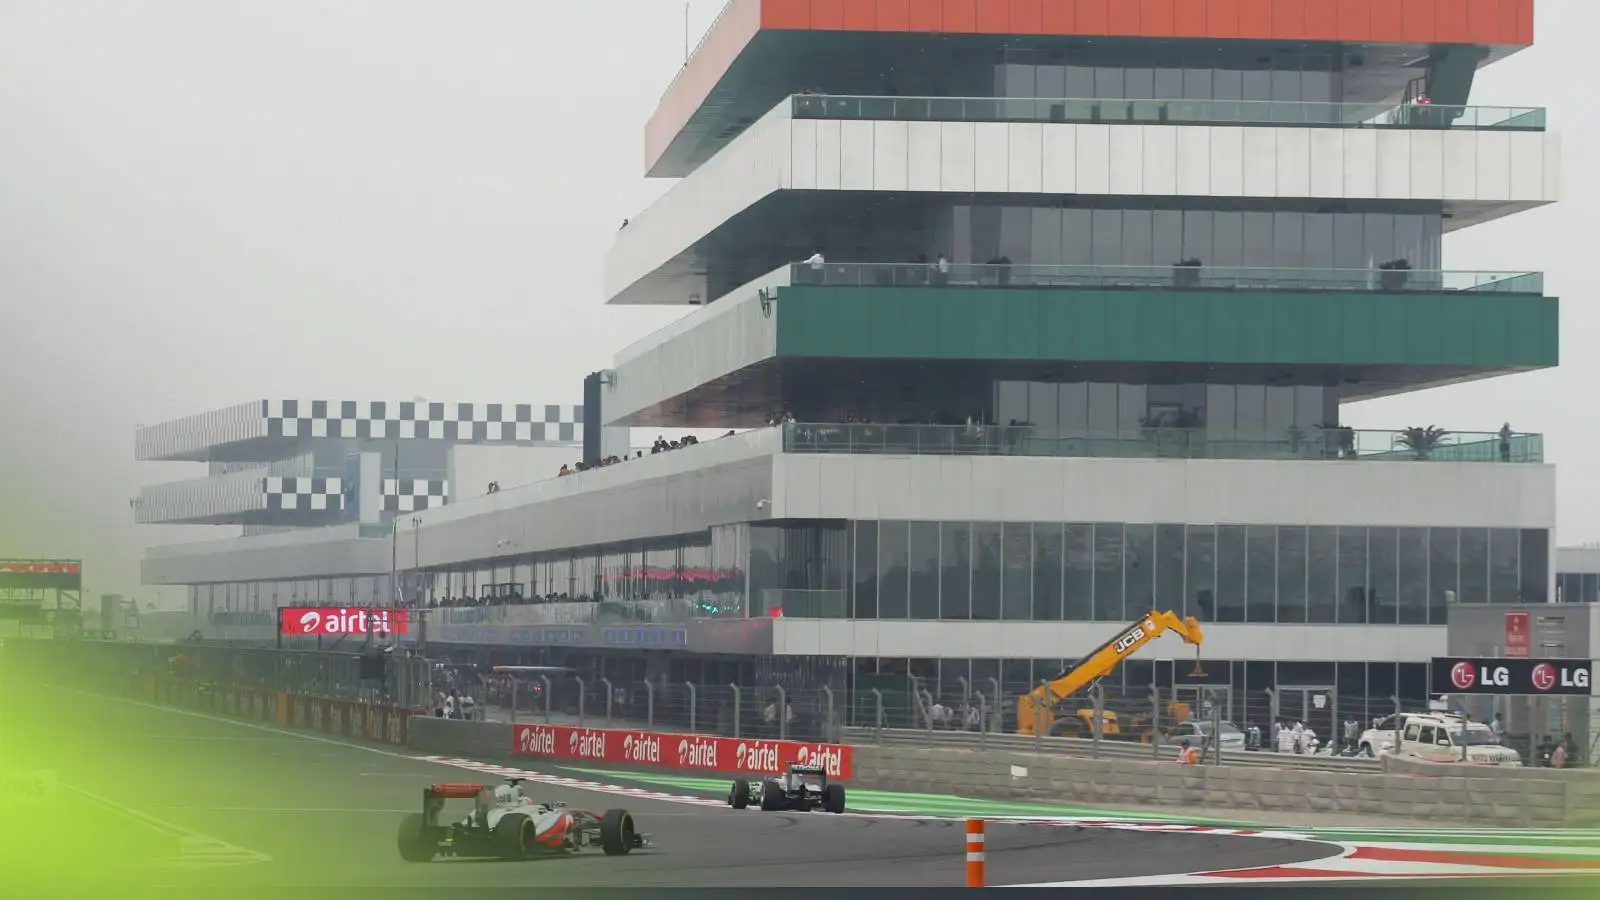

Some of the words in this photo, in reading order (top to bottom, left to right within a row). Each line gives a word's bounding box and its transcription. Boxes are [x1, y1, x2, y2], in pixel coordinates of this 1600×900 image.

[325, 609, 391, 633] airtel
[1116, 628, 1145, 653] JCB
[1481, 666, 1509, 686] LG
[1561, 668, 1588, 687] LG
[530, 727, 554, 754] airtel
[579, 729, 605, 758] airtel
[633, 732, 660, 762] airtel
[689, 738, 717, 767] airtel
[747, 741, 778, 771] airtel
[809, 745, 841, 776] airtel
